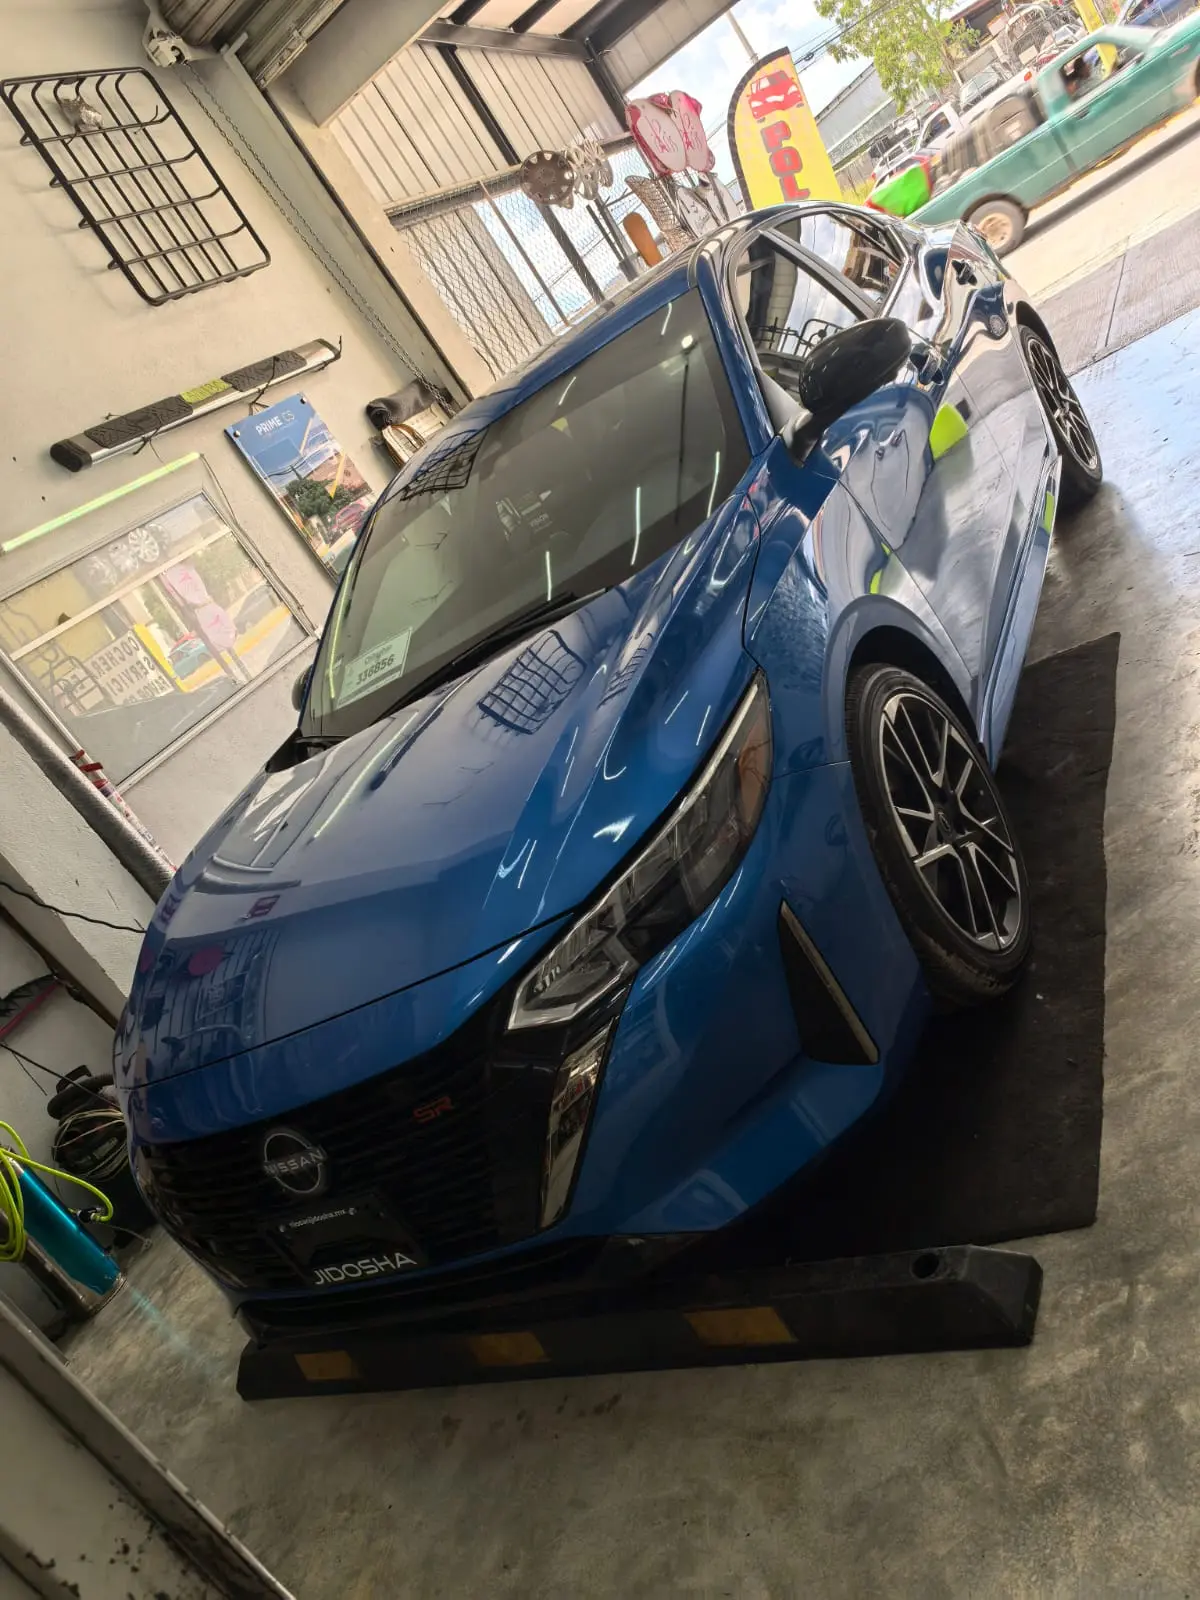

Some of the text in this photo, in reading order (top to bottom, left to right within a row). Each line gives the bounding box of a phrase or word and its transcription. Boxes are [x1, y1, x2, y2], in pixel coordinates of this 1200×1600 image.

[760, 120, 811, 202] POL
[255, 415, 284, 436] PRIME
[413, 1096, 454, 1124] SR
[264, 1147, 325, 1174] NISSAN
[314, 1252, 418, 1285] JIDOSHA
